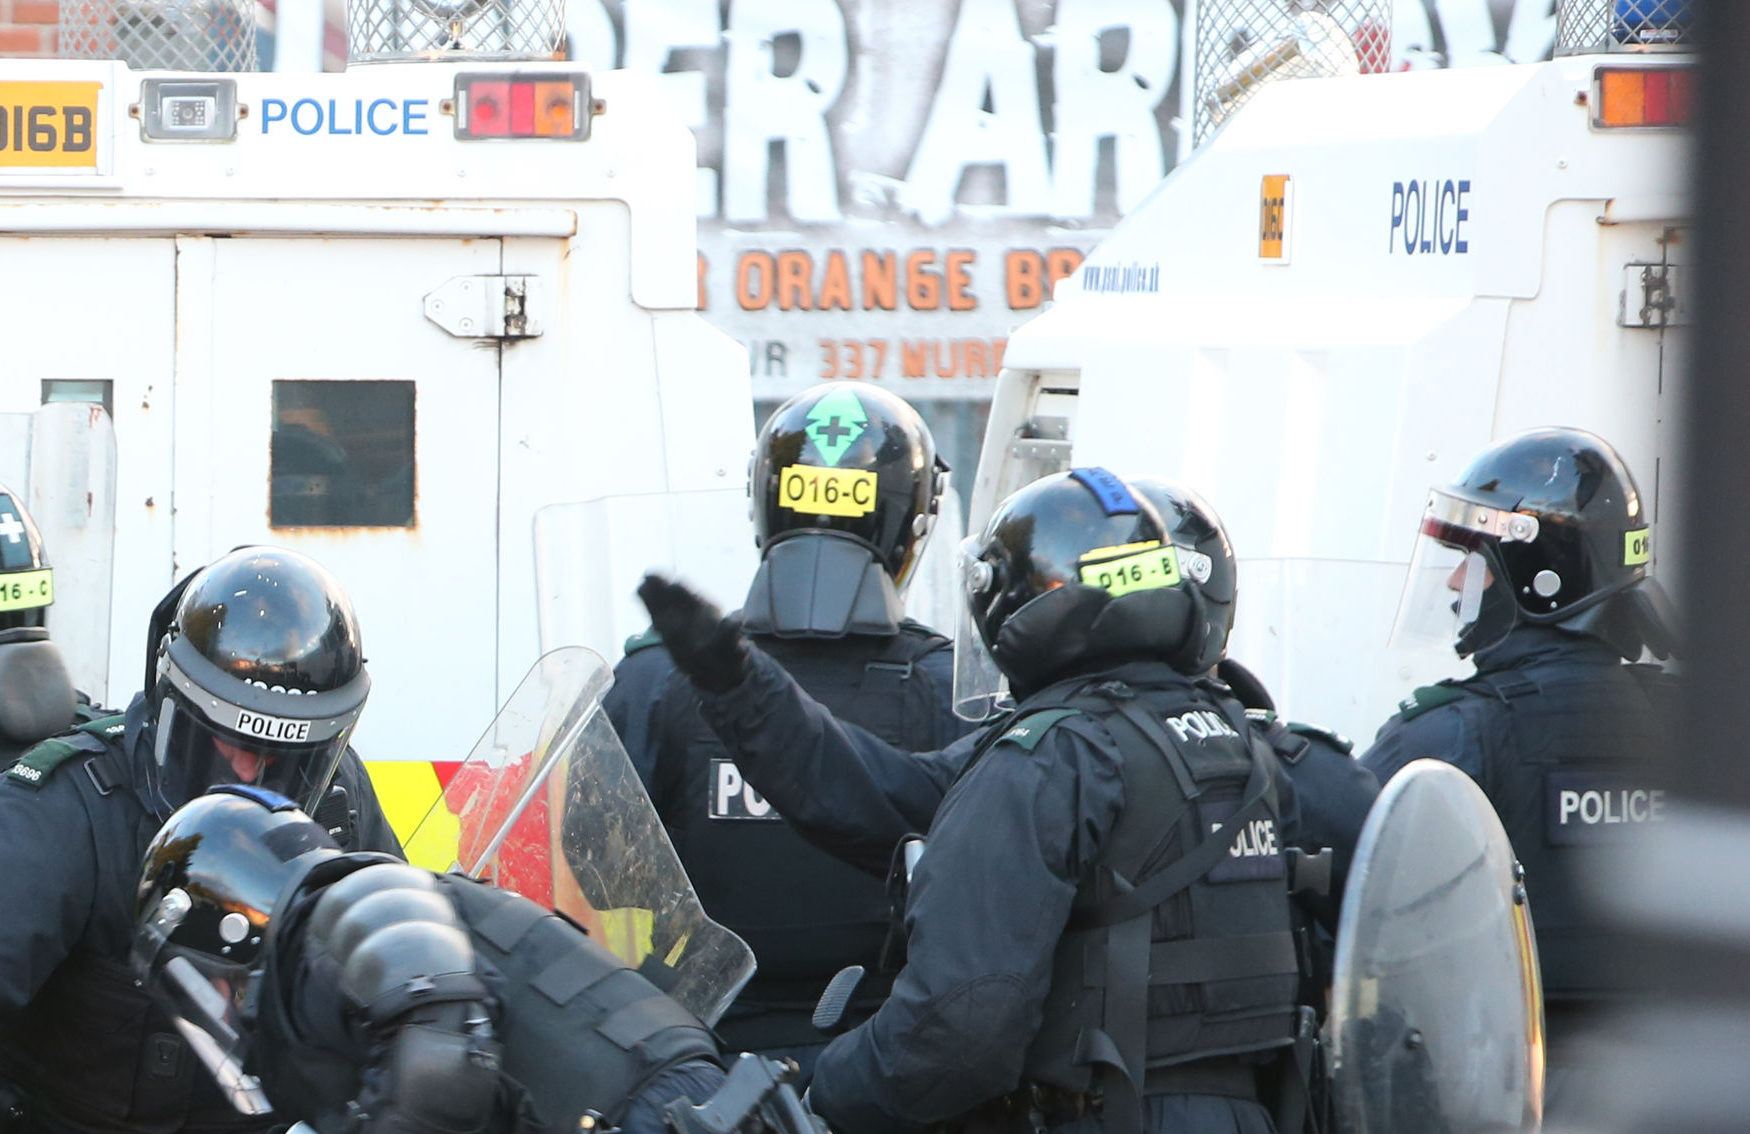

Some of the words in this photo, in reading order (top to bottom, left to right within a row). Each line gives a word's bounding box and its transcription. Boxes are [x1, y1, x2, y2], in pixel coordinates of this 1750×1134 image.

[260, 98, 429, 135] POLICE
[1389, 180, 1471, 254] POLICE
[736, 249, 979, 311] ORANGE
[818, 340, 888, 378] 337
[238, 713, 308, 740] POLICE
[1560, 789, 1665, 824] POLICE
